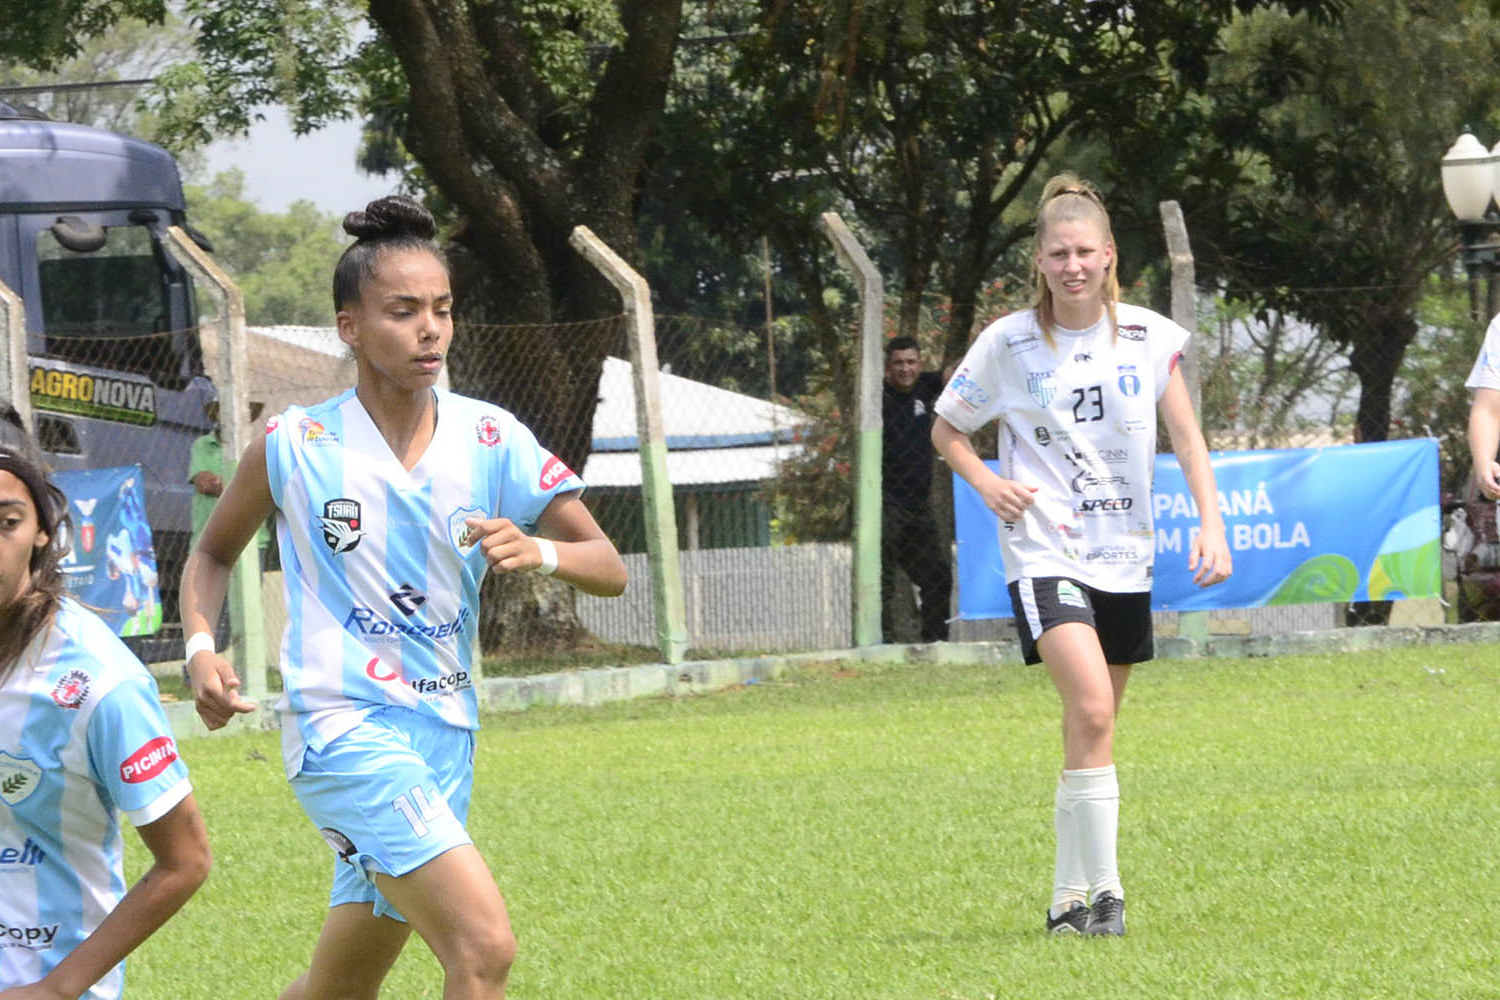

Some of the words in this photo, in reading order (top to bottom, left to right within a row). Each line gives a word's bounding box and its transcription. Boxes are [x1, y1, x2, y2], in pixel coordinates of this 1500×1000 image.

[31, 367, 155, 412] AGRONOVA
[1071, 385, 1105, 424] 23
[1233, 521, 1311, 550] BOLA
[391, 784, 446, 839] 14
